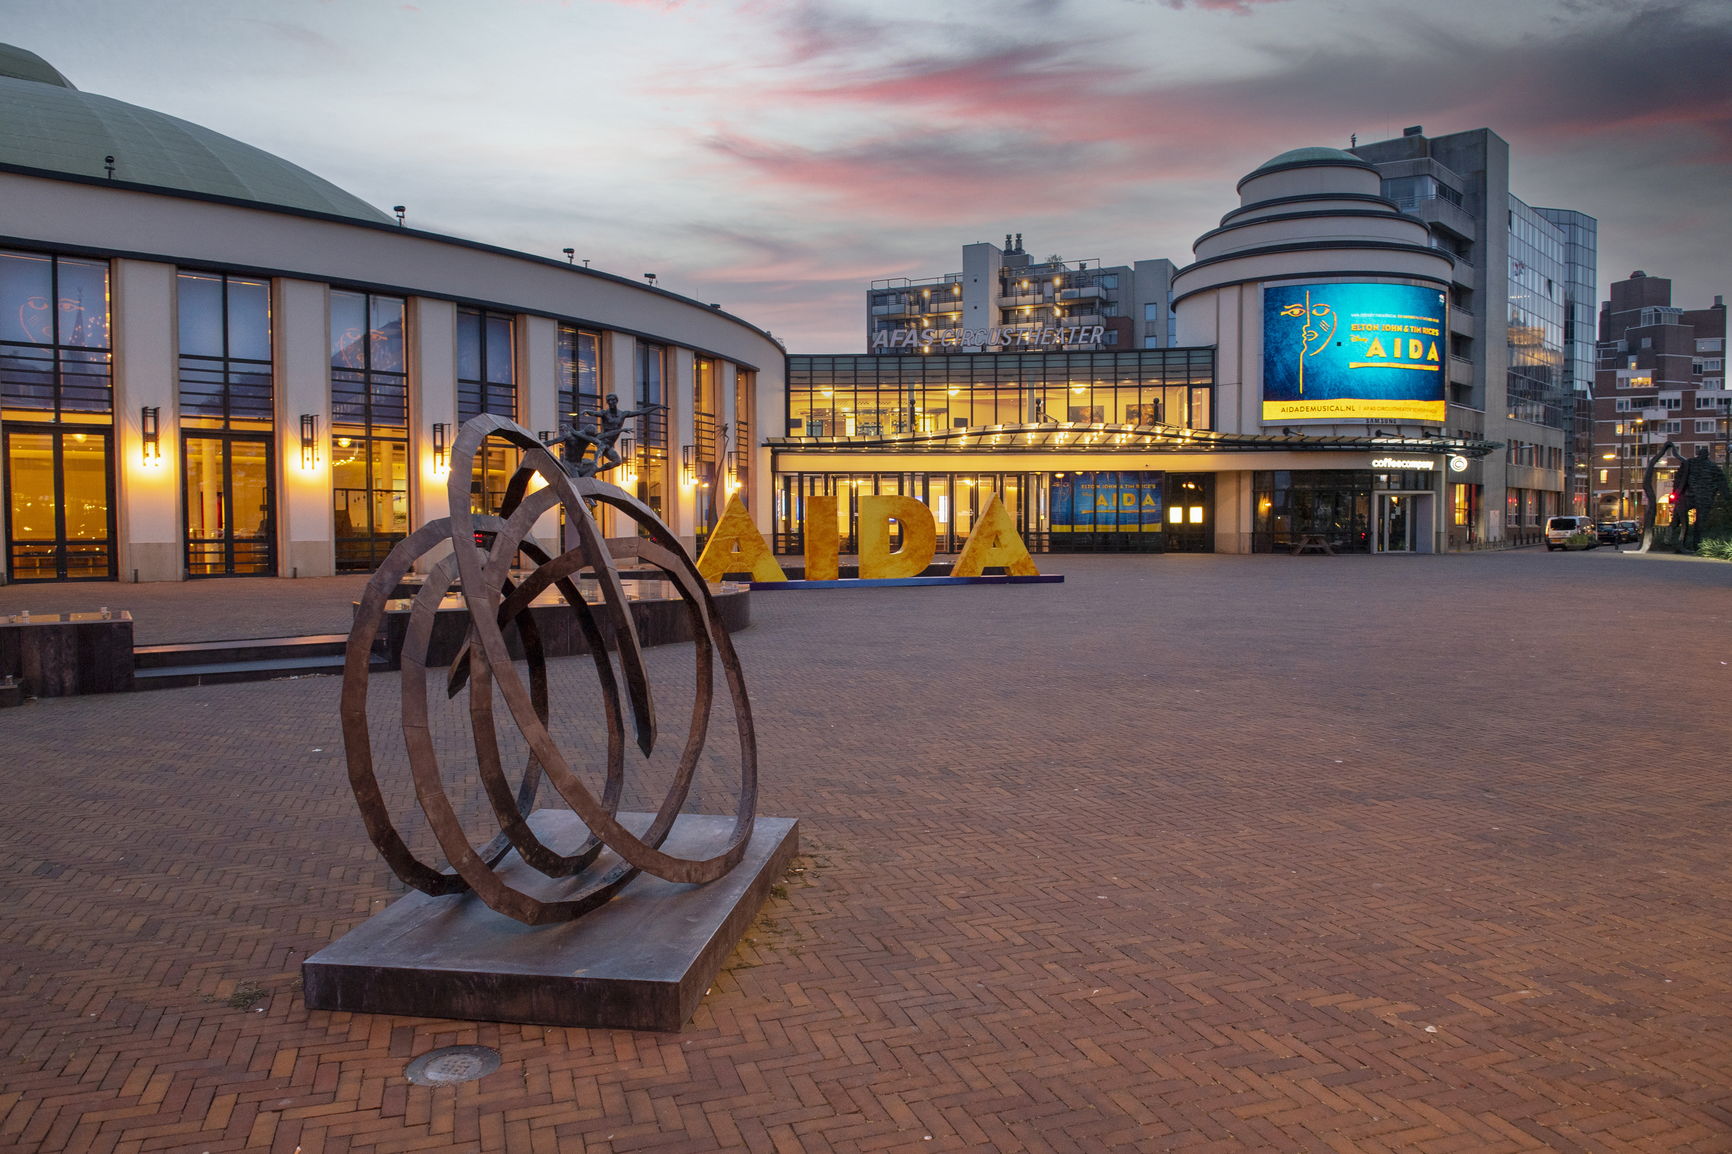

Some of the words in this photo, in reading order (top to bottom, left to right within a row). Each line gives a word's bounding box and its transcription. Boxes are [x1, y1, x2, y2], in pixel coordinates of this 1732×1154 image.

[1382, 324, 1402, 332] JOHN
[1410, 326, 1422, 334] TIM
[871, 328, 937, 348] AFAS
[940, 325, 1106, 347] CIRCUSTHEATER
[1365, 337, 1440, 362] AIDA
[1281, 405, 1356, 413] AIDADEMUSICAL.NL
[1371, 457, 1434, 471] coffeecompany
[1096, 493, 1156, 507] AIDA
[695, 491, 1041, 583] AIDA
